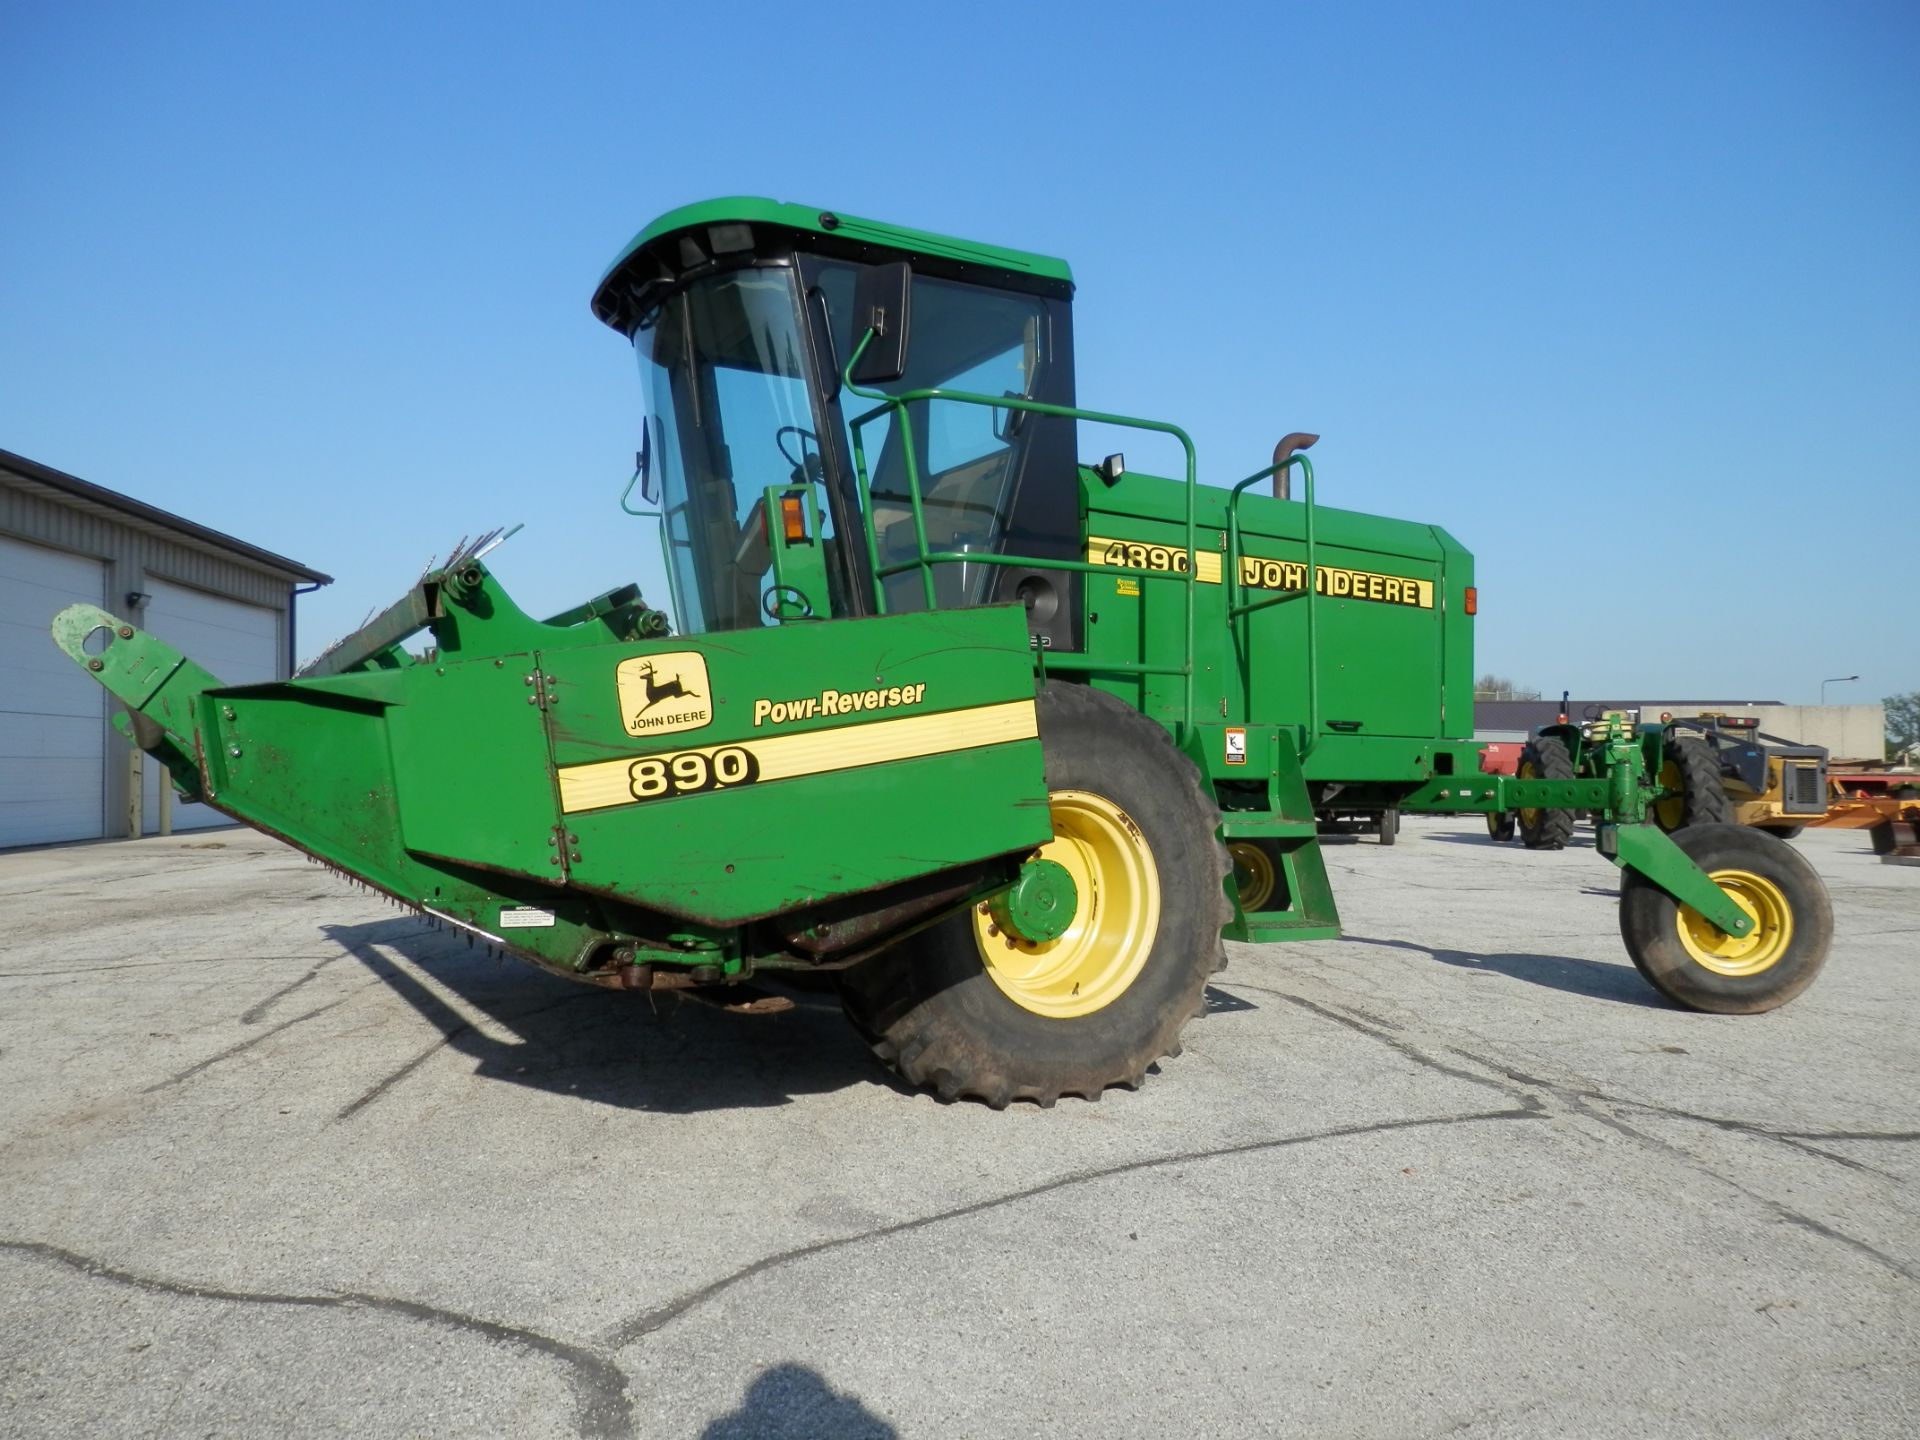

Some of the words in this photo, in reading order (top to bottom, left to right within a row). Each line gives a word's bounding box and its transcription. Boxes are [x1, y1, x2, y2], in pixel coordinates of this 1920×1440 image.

[1104, 542, 1195, 573] 4890
[1333, 570, 1419, 606] DEERE
[631, 716, 664, 730] JOHN
[667, 710, 707, 725] DEERE
[753, 682, 926, 727] Powr-Reverser
[629, 746, 759, 802] 890
